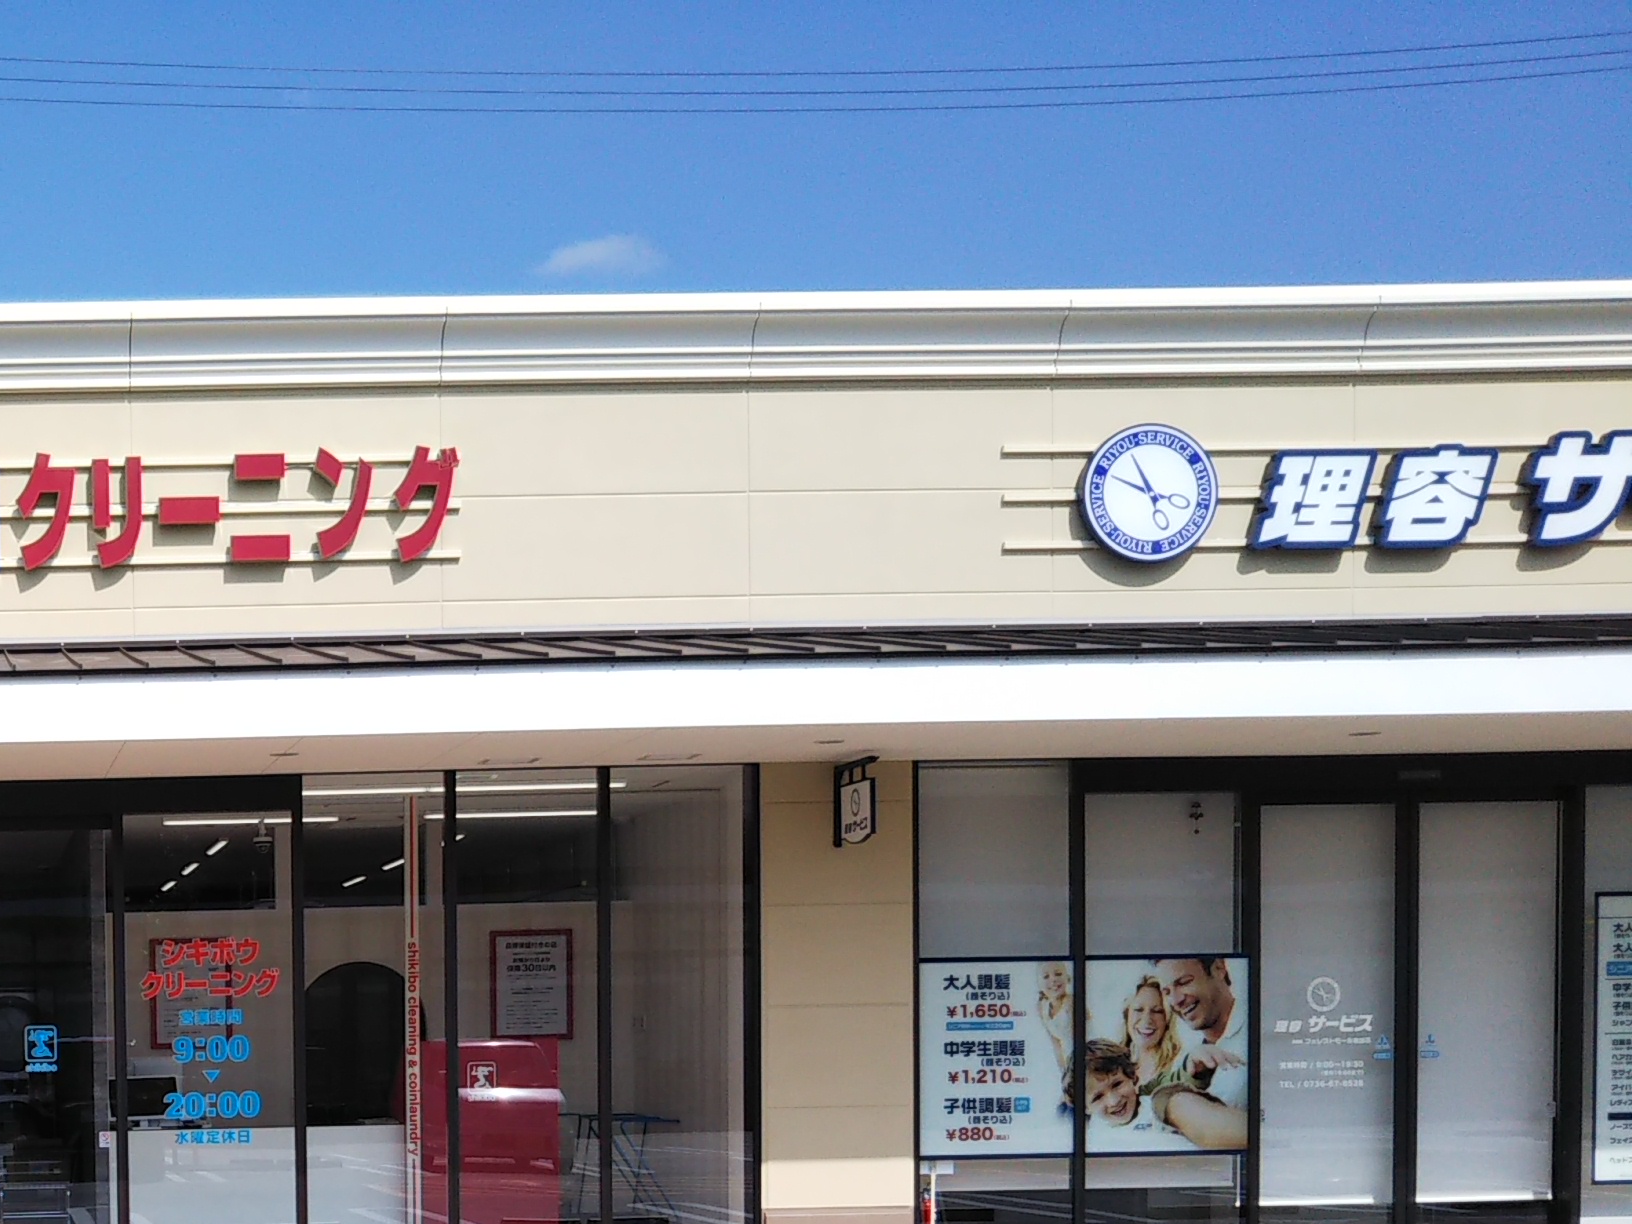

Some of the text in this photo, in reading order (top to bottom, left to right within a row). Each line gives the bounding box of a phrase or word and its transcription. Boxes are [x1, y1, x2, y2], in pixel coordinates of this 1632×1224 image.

[16, 446, 459, 570] クリーニング
[162, 937, 261, 967] シキボウ
[141, 968, 279, 1000] クリーニング
[943, 974, 1011, 990] 大人調髪
[179, 1009, 243, 1026] 営業時間
[1308, 1014, 1374, 1033] サービス
[172, 1035, 251, 1064] 9:00
[407, 942, 421, 1157] shikibo cleaning & coinlaundry
[944, 1040, 1025, 1058] 中学生調髪
[163, 1090, 261, 1119] 20:00
[944, 1097, 1012, 1114] 子供調髪
[174, 1130, 252, 1144] 水曜定休日
[946, 1126, 994, 1141] ¥880
